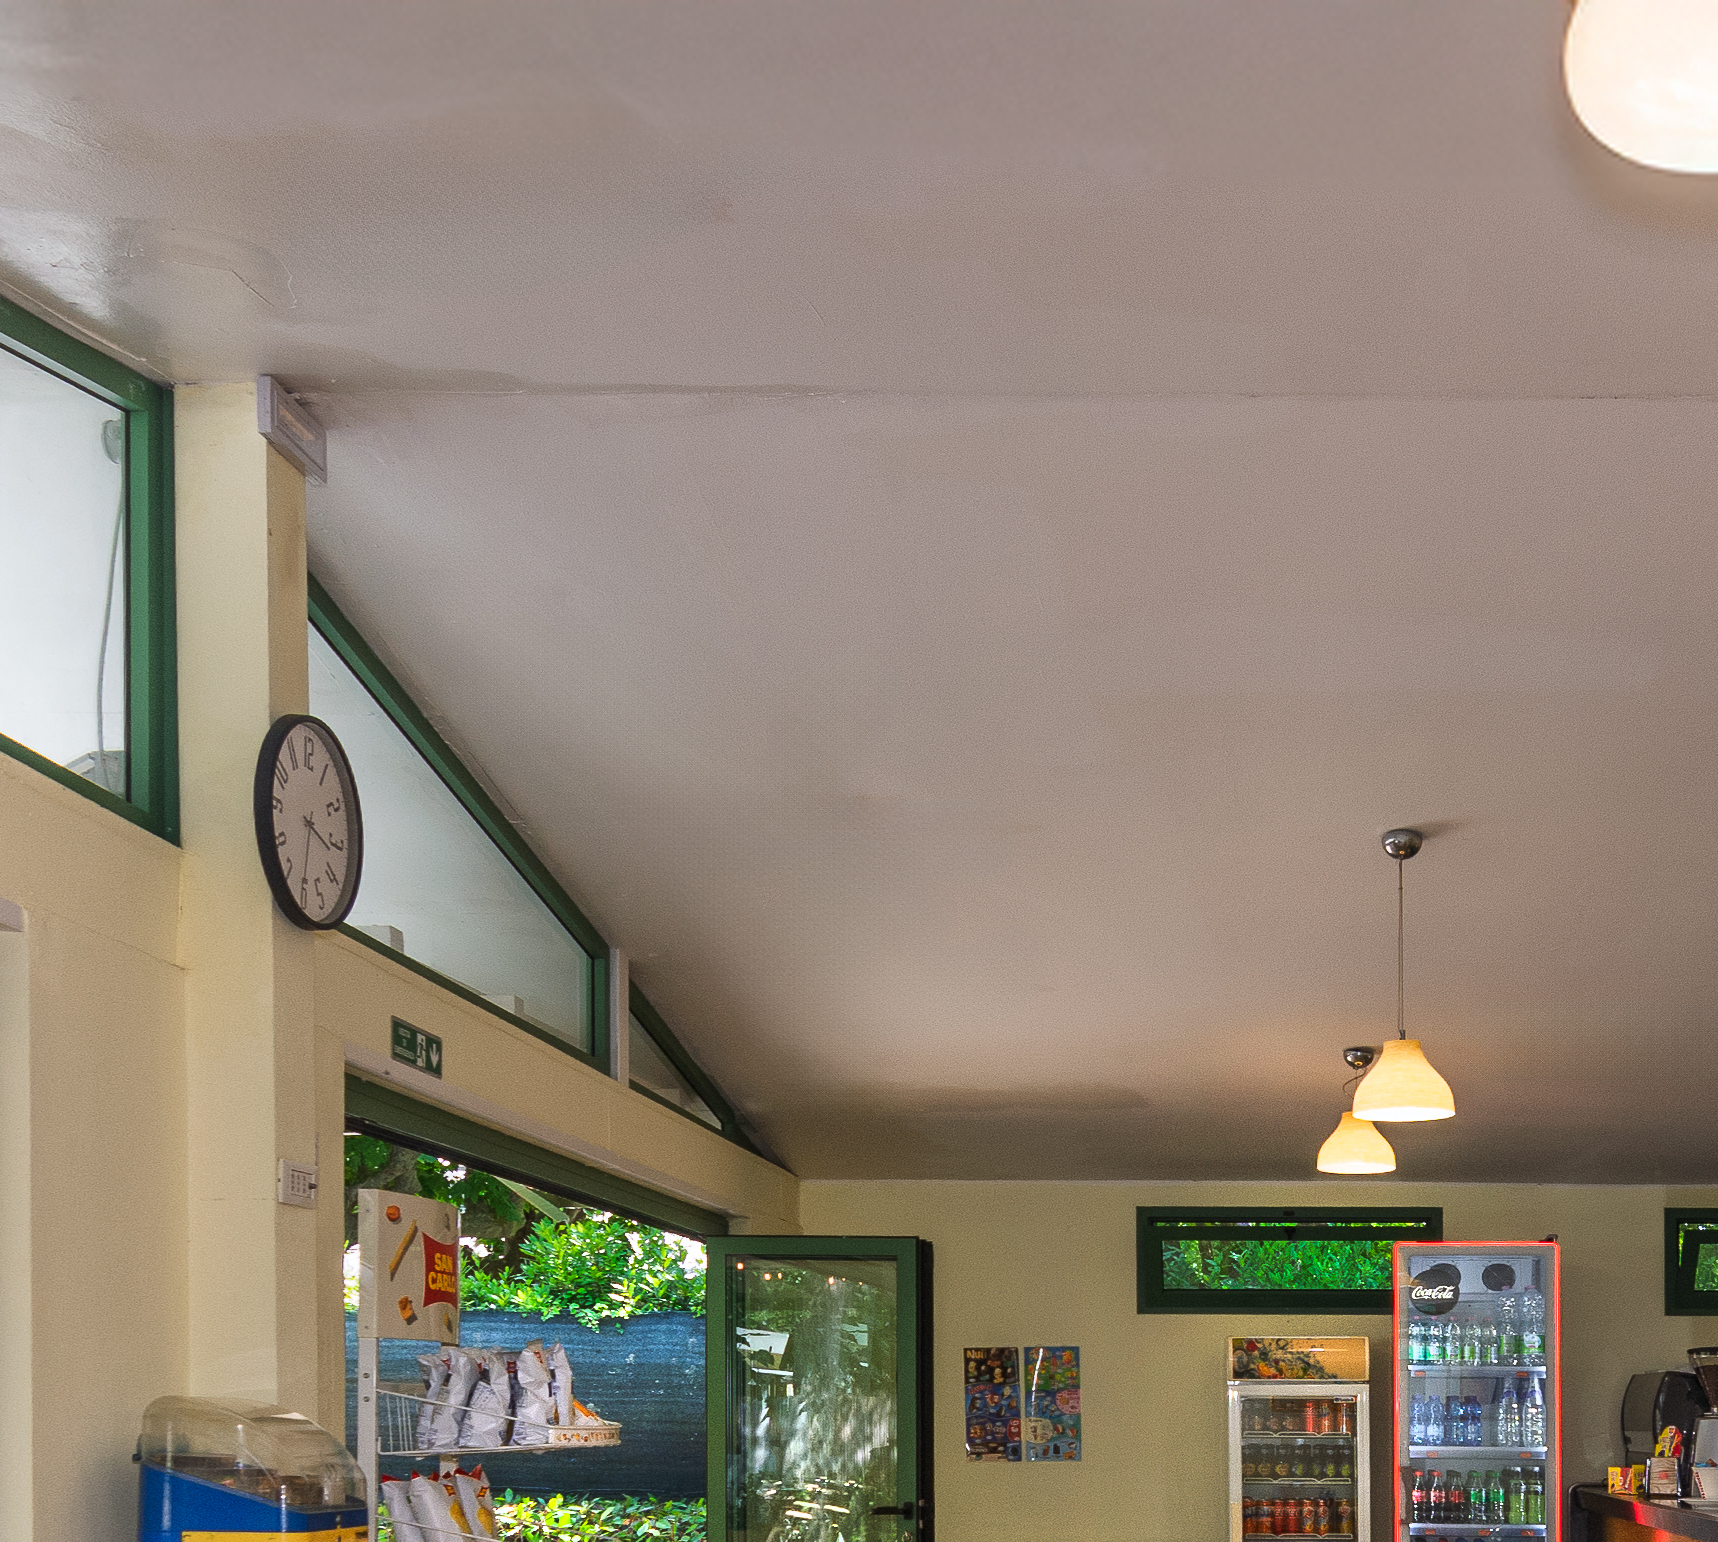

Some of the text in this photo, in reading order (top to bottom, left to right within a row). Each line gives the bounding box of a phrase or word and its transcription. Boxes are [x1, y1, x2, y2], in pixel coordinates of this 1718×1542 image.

[304, 735, 315, 772] 12
[275, 758, 289, 790] 10
[319, 763, 329, 786] 1
[326, 798, 341, 817] 2
[328, 832, 345, 852] 3
[324, 861, 340, 887] 4
[300, 877, 309, 911] 6
[314, 877, 325, 911] 5
[434, 1252, 453, 1273] SAN
[1411, 1285, 1456, 1300] Coca-Cola
